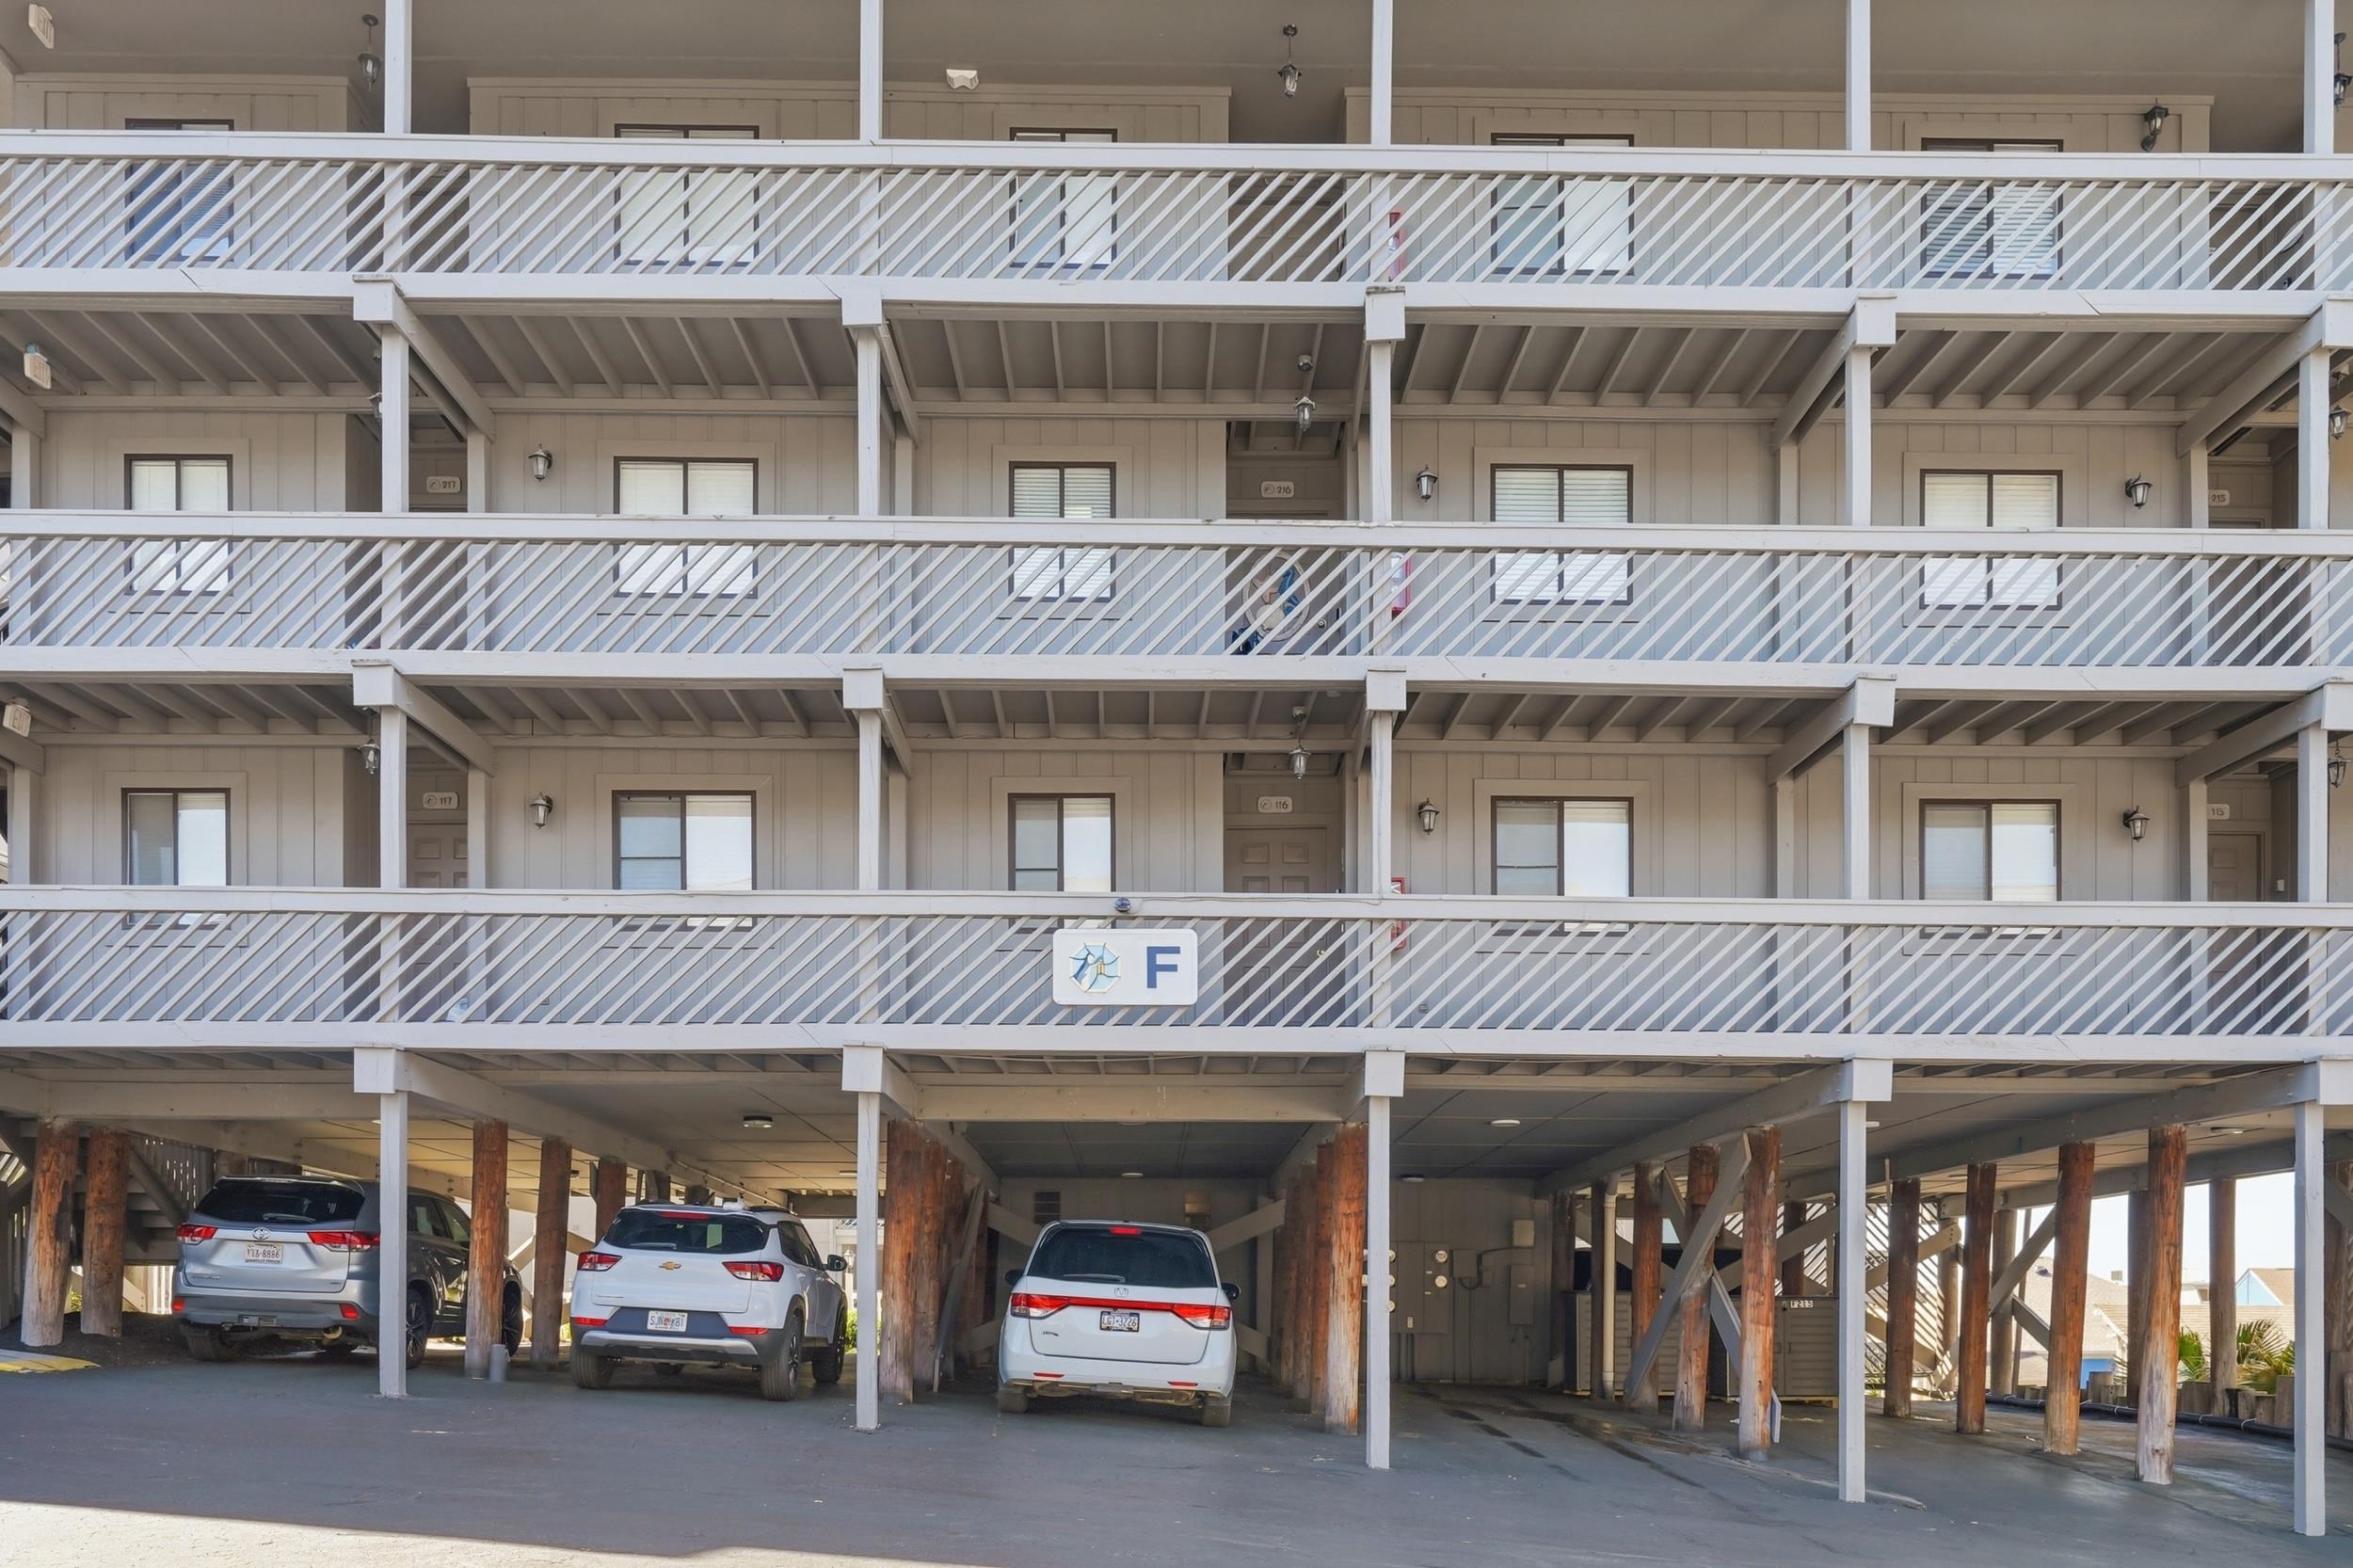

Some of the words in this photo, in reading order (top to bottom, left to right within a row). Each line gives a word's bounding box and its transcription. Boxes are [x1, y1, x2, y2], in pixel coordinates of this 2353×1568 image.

[442, 480, 456, 488] 217
[1277, 486, 1291, 494] 216
[2211, 494, 2226, 503] 215
[1275, 801, 1289, 809] 116
[2212, 808, 2225, 816] 115
[1146, 946, 1181, 989] F
[1791, 1300, 1814, 1308] F215
